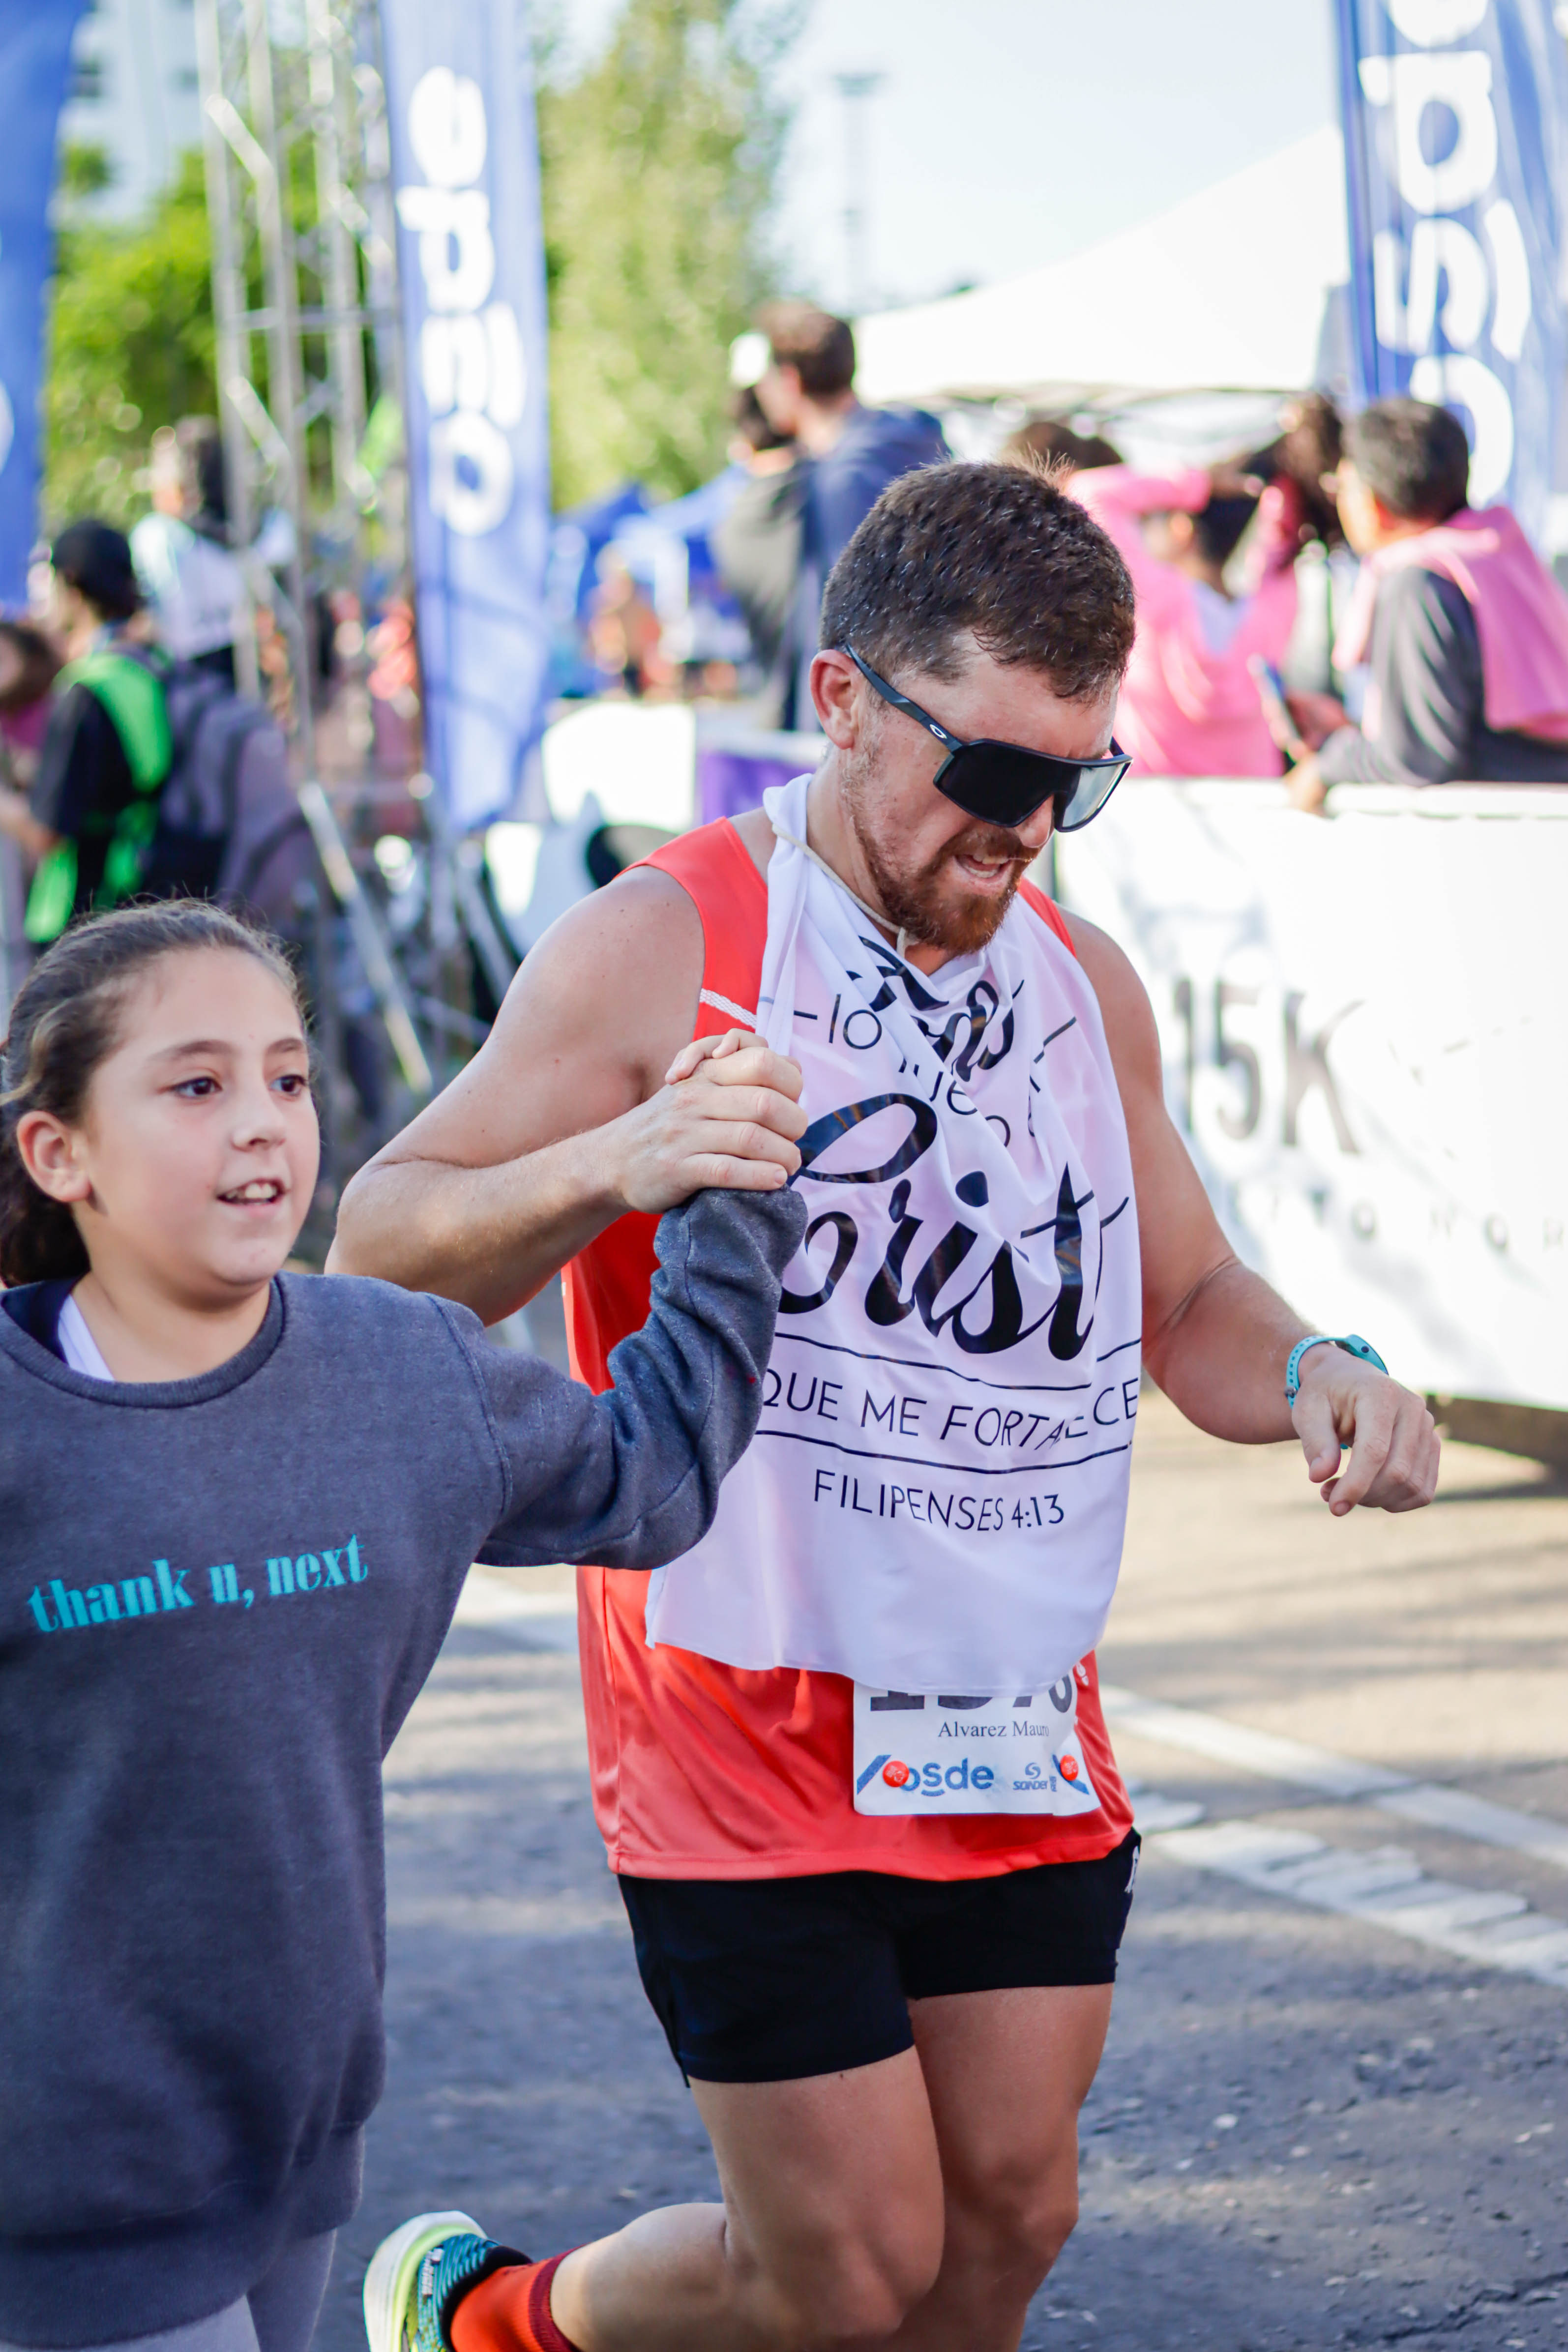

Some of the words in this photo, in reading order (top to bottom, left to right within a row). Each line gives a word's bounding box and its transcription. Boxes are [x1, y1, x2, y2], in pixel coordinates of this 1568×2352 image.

[396, 65, 517, 536] osde
[1174, 976, 1366, 1155] 15K
[860, 1389, 927, 1436] ME
[940, 1378, 1138, 1450] FORTACE
[814, 1469, 1004, 1531] FILIPENSES
[1011, 1494, 1064, 1529] 4:13
[28, 1558, 195, 1632] thank
[209, 1563, 255, 1608] u,
[266, 1533, 368, 1596] next
[938, 1721, 1007, 1737] Alvarez
[1012, 1720, 1050, 1736] Mauro
